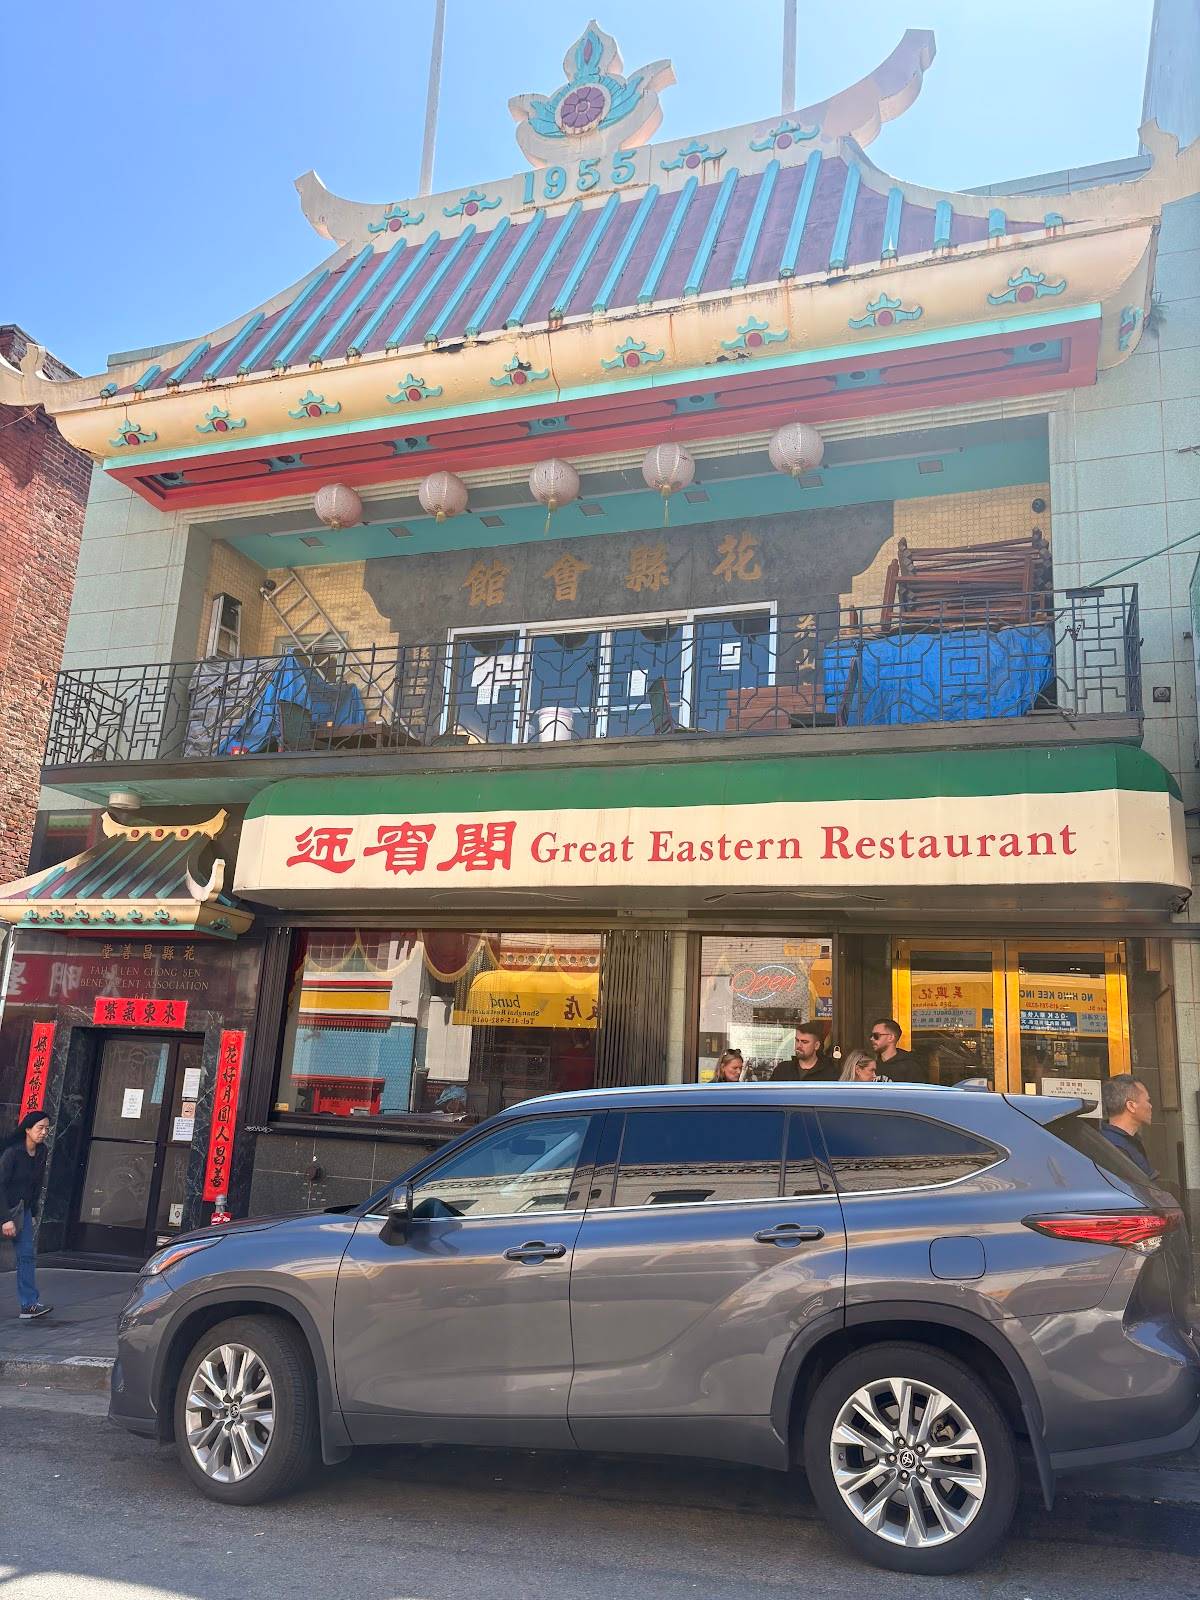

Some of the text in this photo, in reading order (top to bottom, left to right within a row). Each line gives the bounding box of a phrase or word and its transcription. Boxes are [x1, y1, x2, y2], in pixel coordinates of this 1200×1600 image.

[522, 150, 637, 205] 1955
[464, 532, 763, 608] 花縣會館
[530, 824, 1078, 863] Great Eastern Restaurant
[143, 968, 178, 977] CHONG
[182, 969, 201, 977] SEN
[145, 981, 209, 991] ASSOCIATION
[731, 969, 797, 997] Open
[210, 1044, 237, 1188] 花好月圓人昌善
